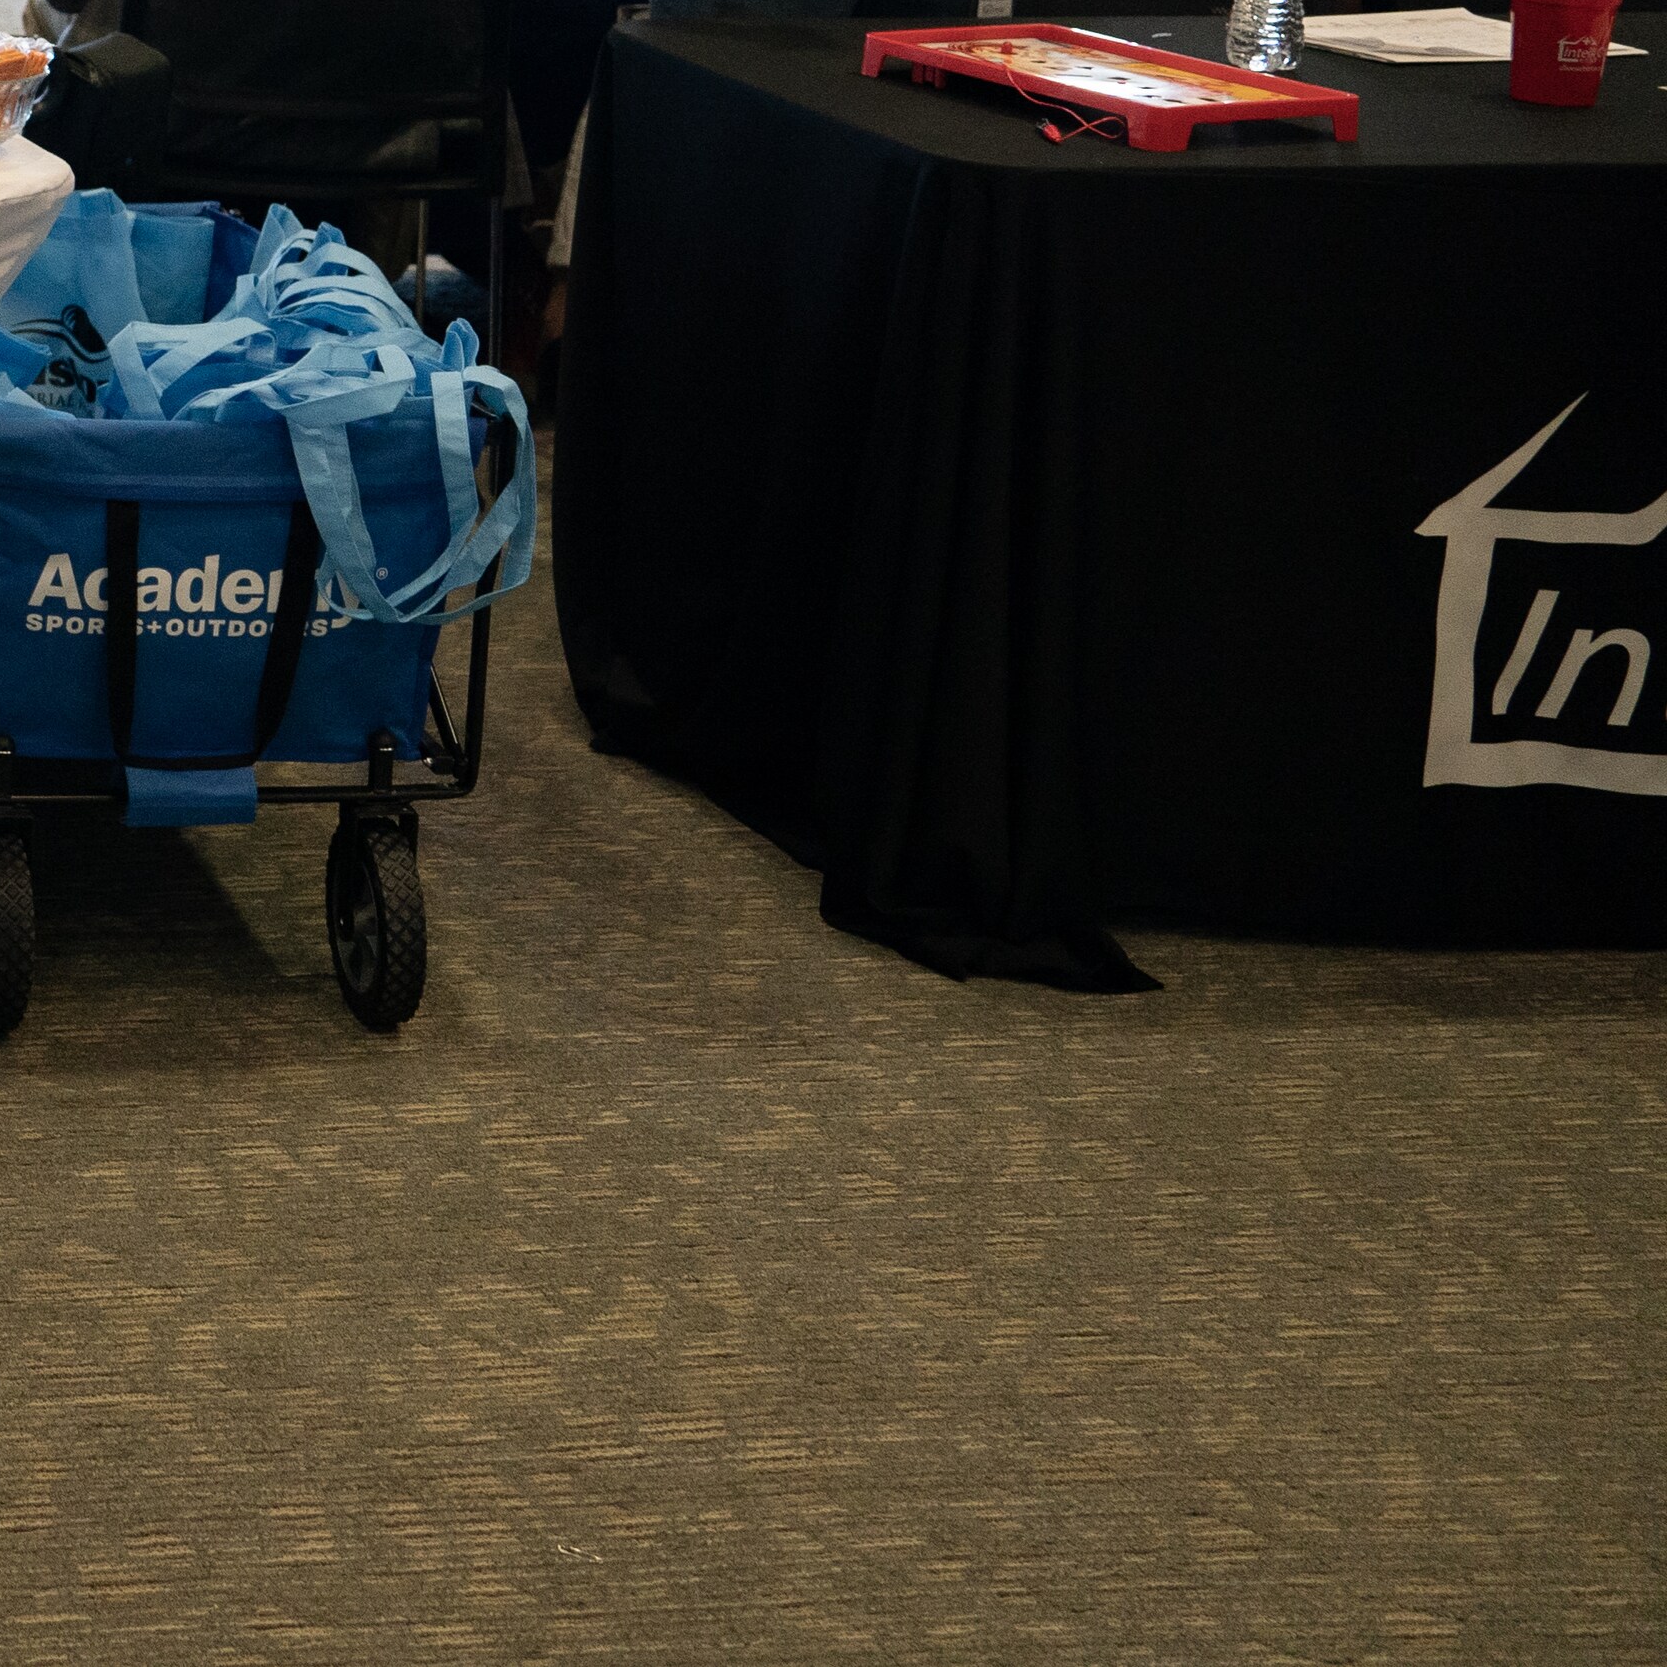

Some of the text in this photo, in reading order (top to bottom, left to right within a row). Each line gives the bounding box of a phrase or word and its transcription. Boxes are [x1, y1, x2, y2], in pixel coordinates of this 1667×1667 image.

[33, 356, 110, 404] slo
[25, 613, 329, 637] SPOR+OUTDOS
[1492, 589, 1667, 727] In
